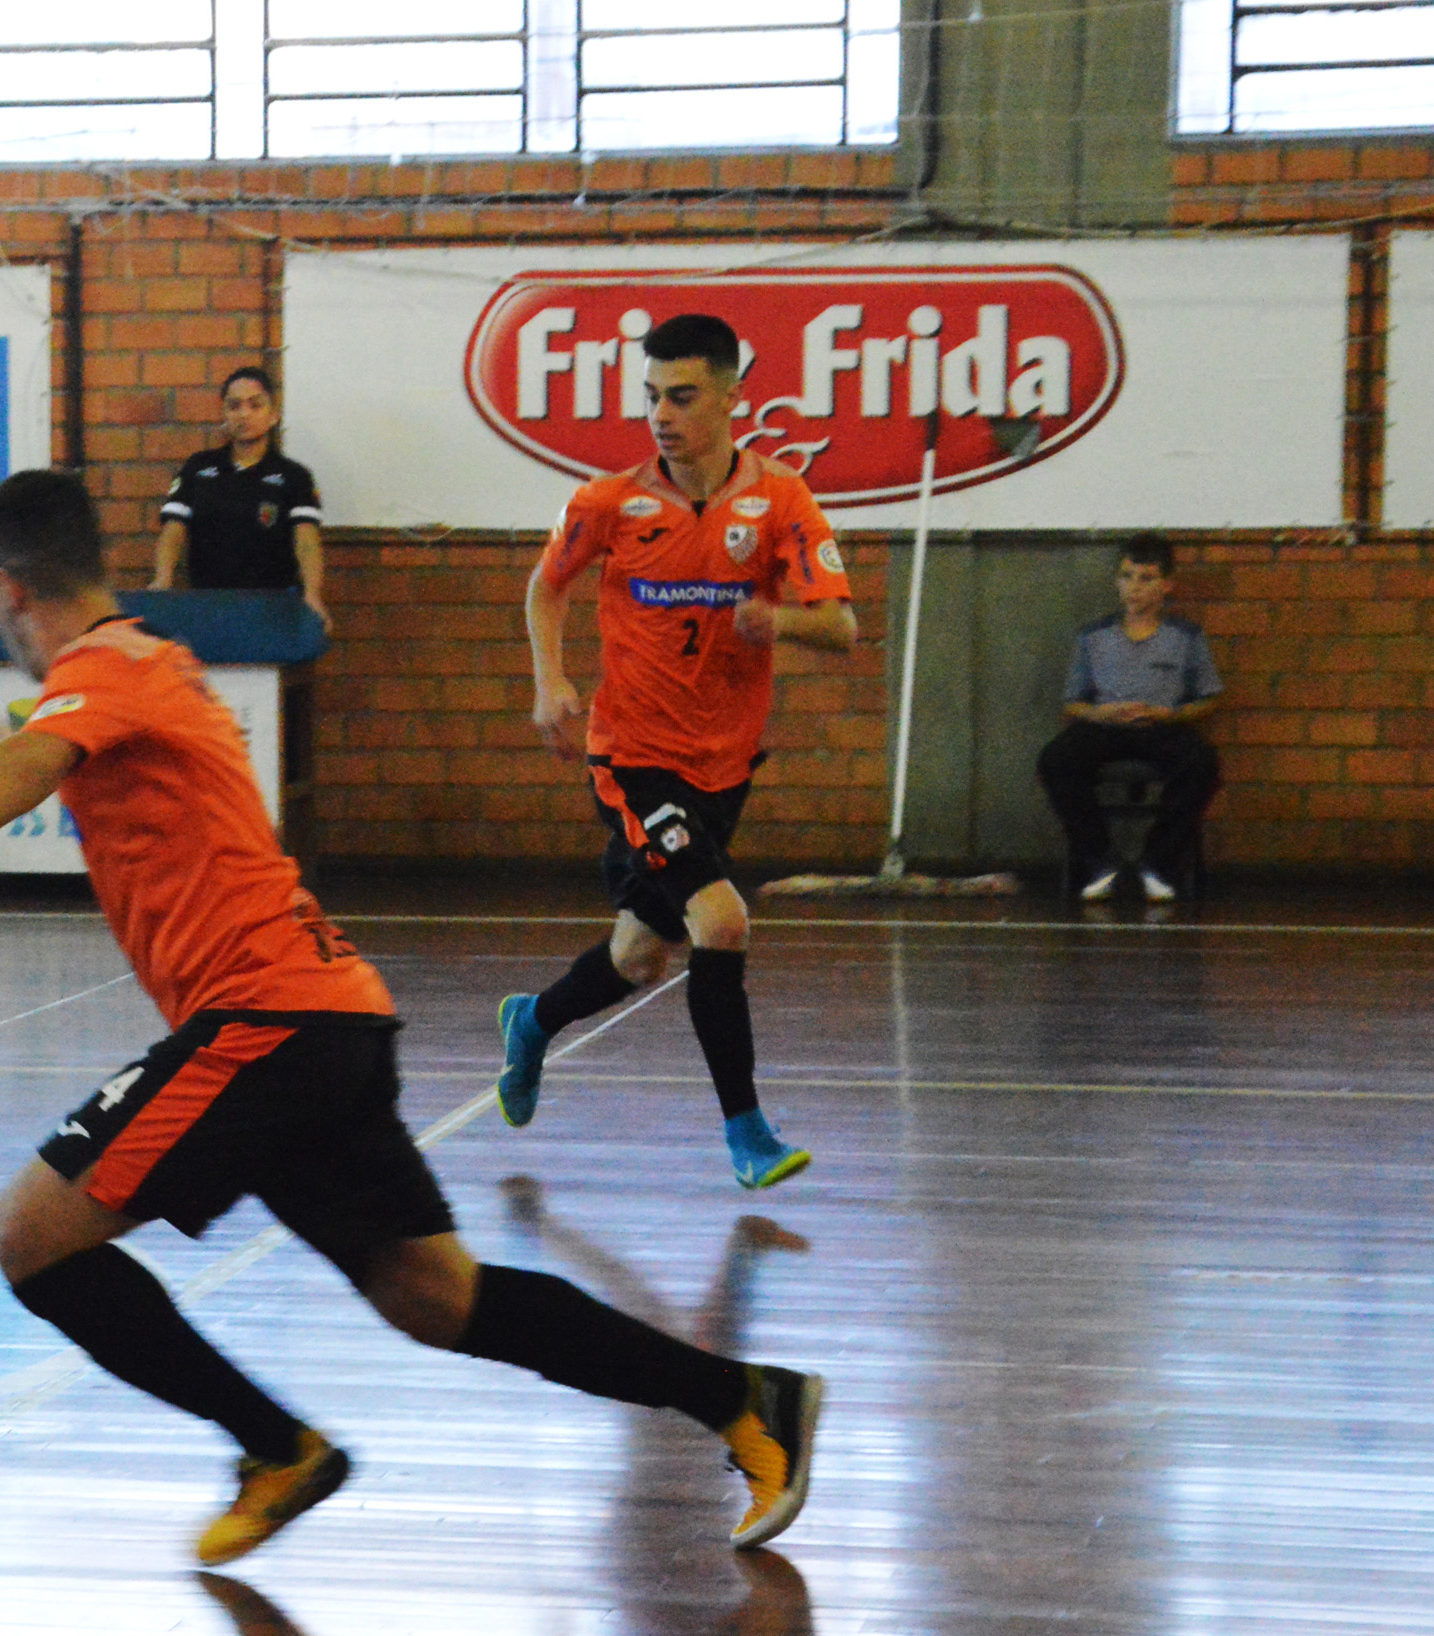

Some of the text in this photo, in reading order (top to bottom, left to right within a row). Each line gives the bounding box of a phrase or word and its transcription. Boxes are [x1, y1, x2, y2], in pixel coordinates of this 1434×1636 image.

[517, 307, 755, 418] Fri
[800, 303, 1071, 418] Frida
[639, 584, 746, 602] TRAMONTINA
[681, 618, 700, 656] 2
[99, 1066, 145, 1112] 4
